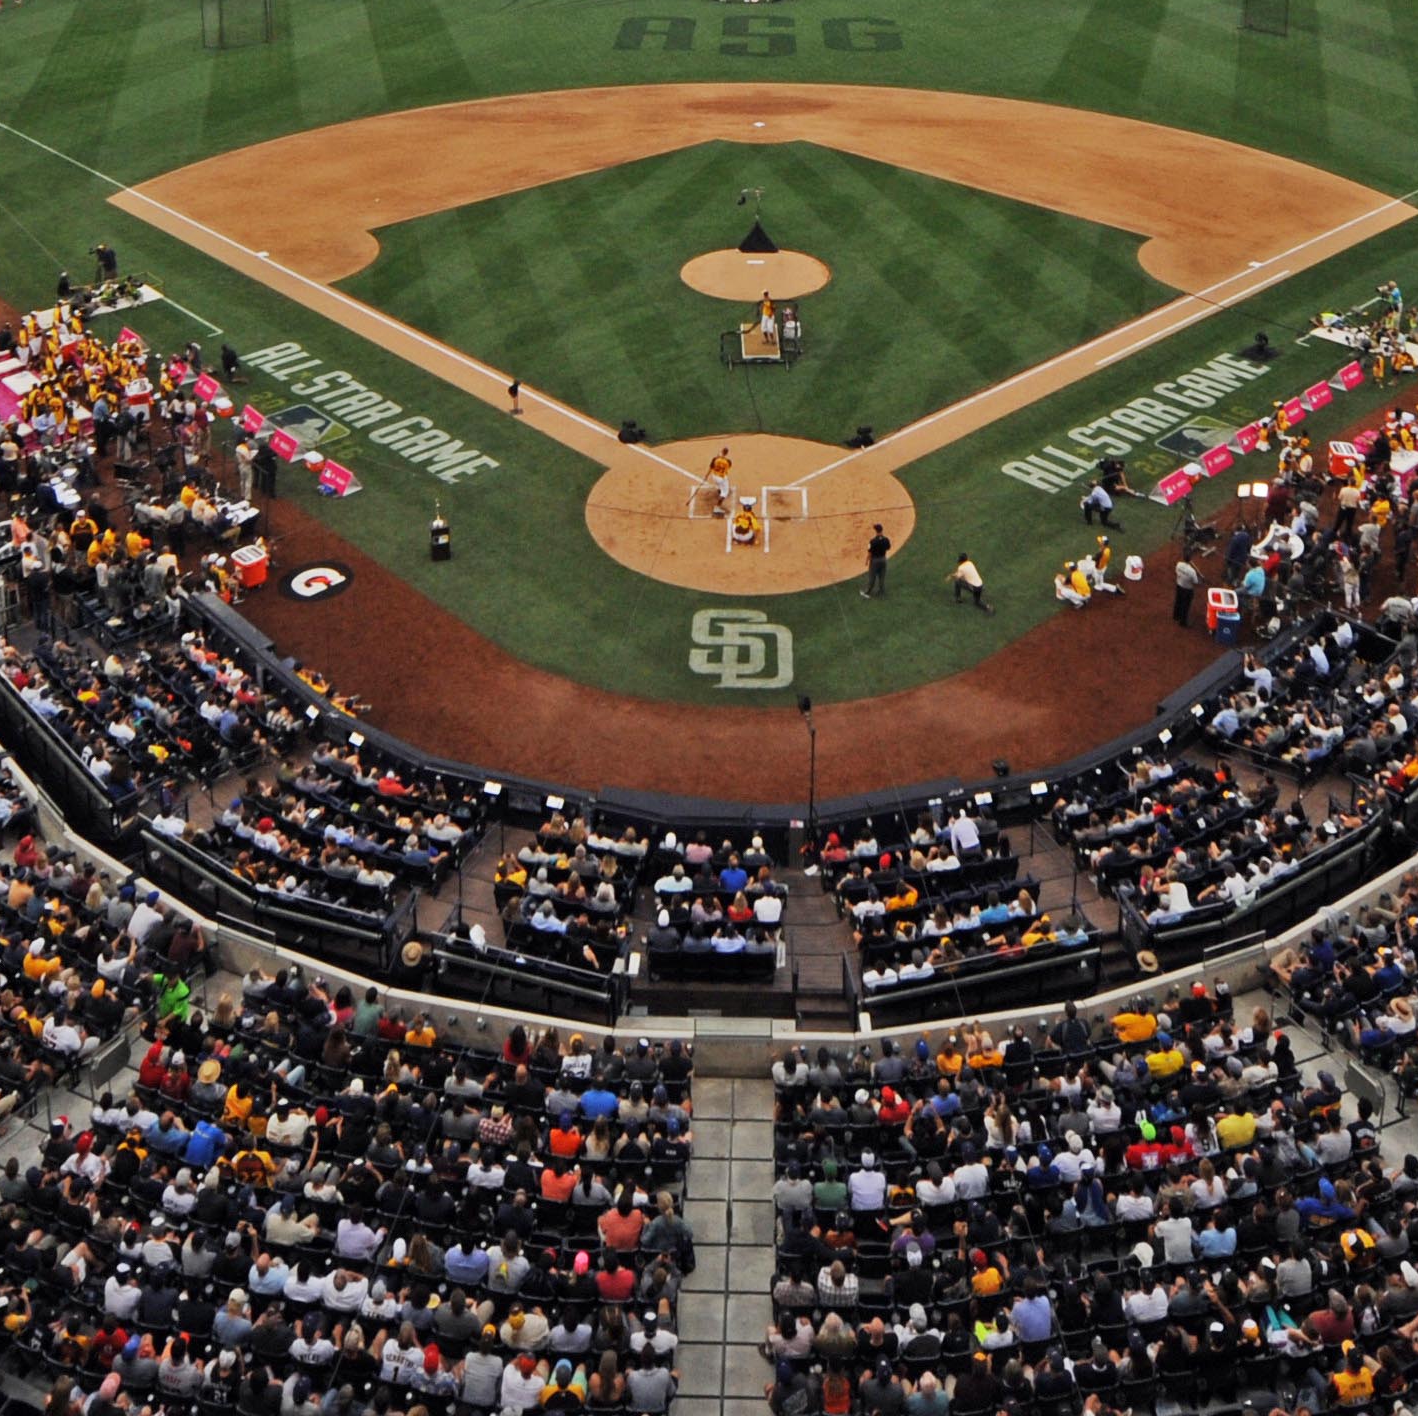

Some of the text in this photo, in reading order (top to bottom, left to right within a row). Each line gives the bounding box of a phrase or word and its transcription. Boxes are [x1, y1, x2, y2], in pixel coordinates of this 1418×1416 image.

[612, 15, 904, 58] ASG
[238, 341, 501, 484] ALL STAR GAME
[1000, 351, 1272, 494] ALL STAR GAME
[290, 567, 347, 597] G
[688, 608, 795, 690] SD
